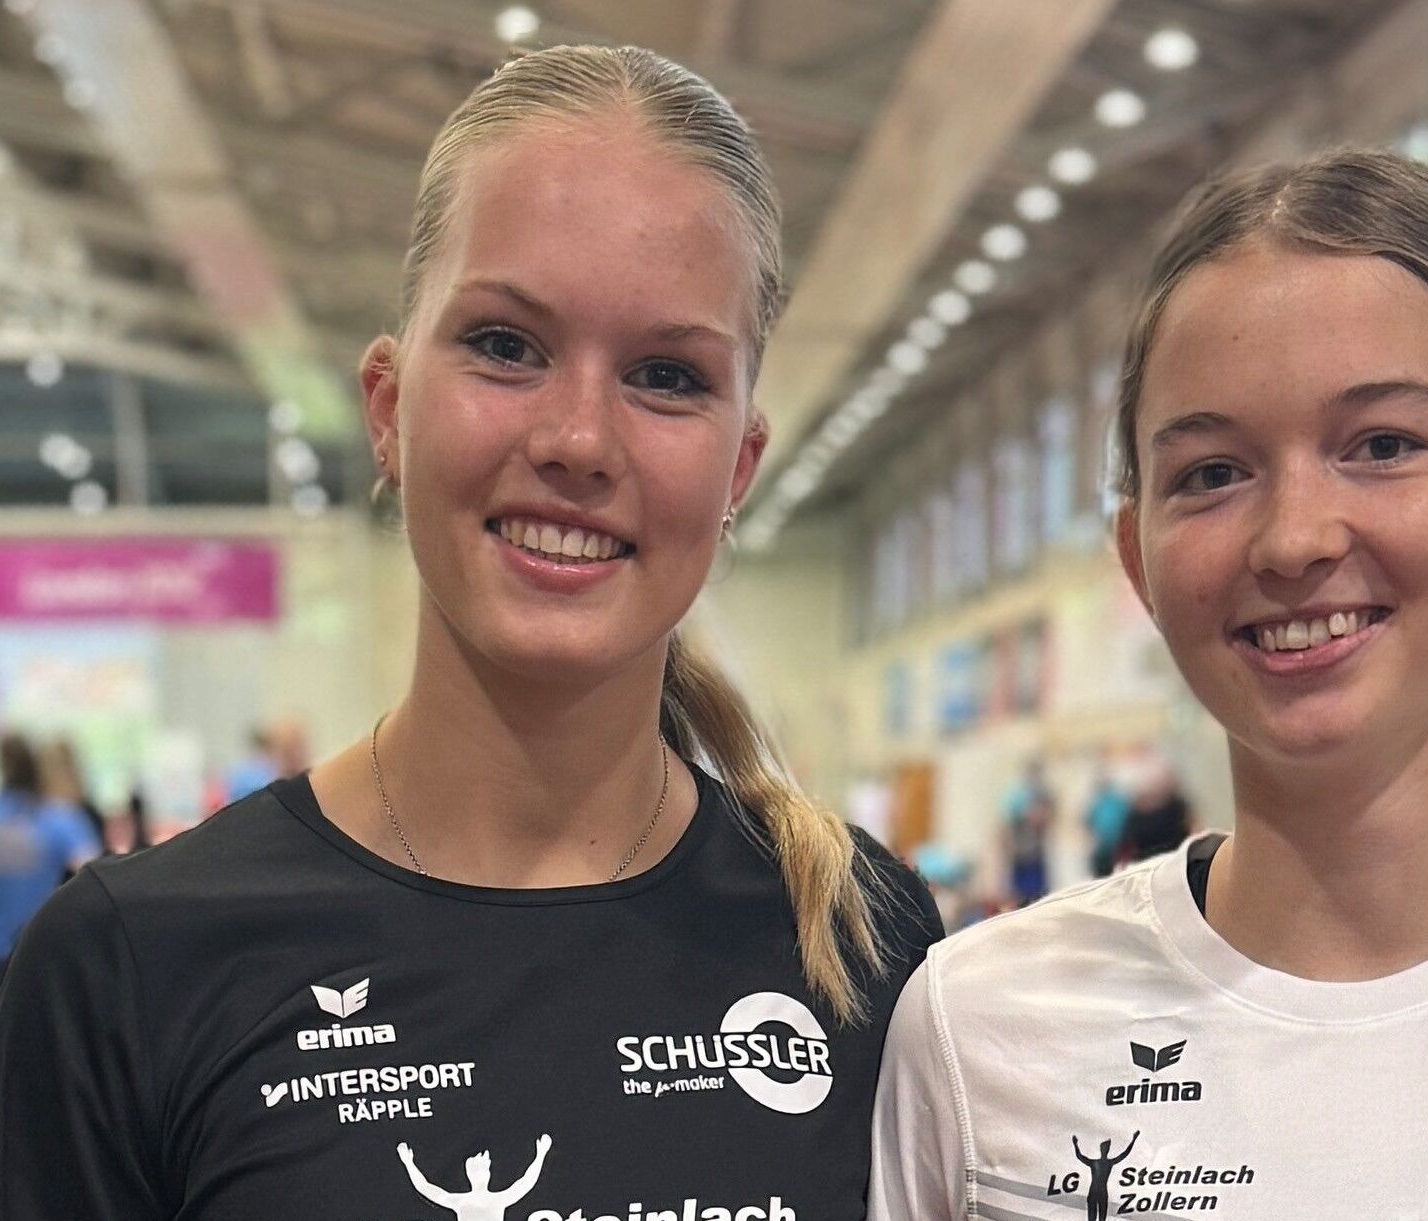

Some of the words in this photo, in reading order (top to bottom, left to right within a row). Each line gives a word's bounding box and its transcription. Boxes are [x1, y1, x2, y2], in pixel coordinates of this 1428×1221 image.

[297, 1023, 396, 1050] erima
[291, 1062, 475, 1102] INTERSPORT
[623, 1079, 651, 1095] the
[1106, 1078, 1202, 1106] erima
[338, 1097, 433, 1123] RÄPPLE
[1047, 1172, 1080, 1196] LG
[1119, 1165, 1255, 1186] Steinlach
[1117, 1191, 1218, 1215] Zollern
